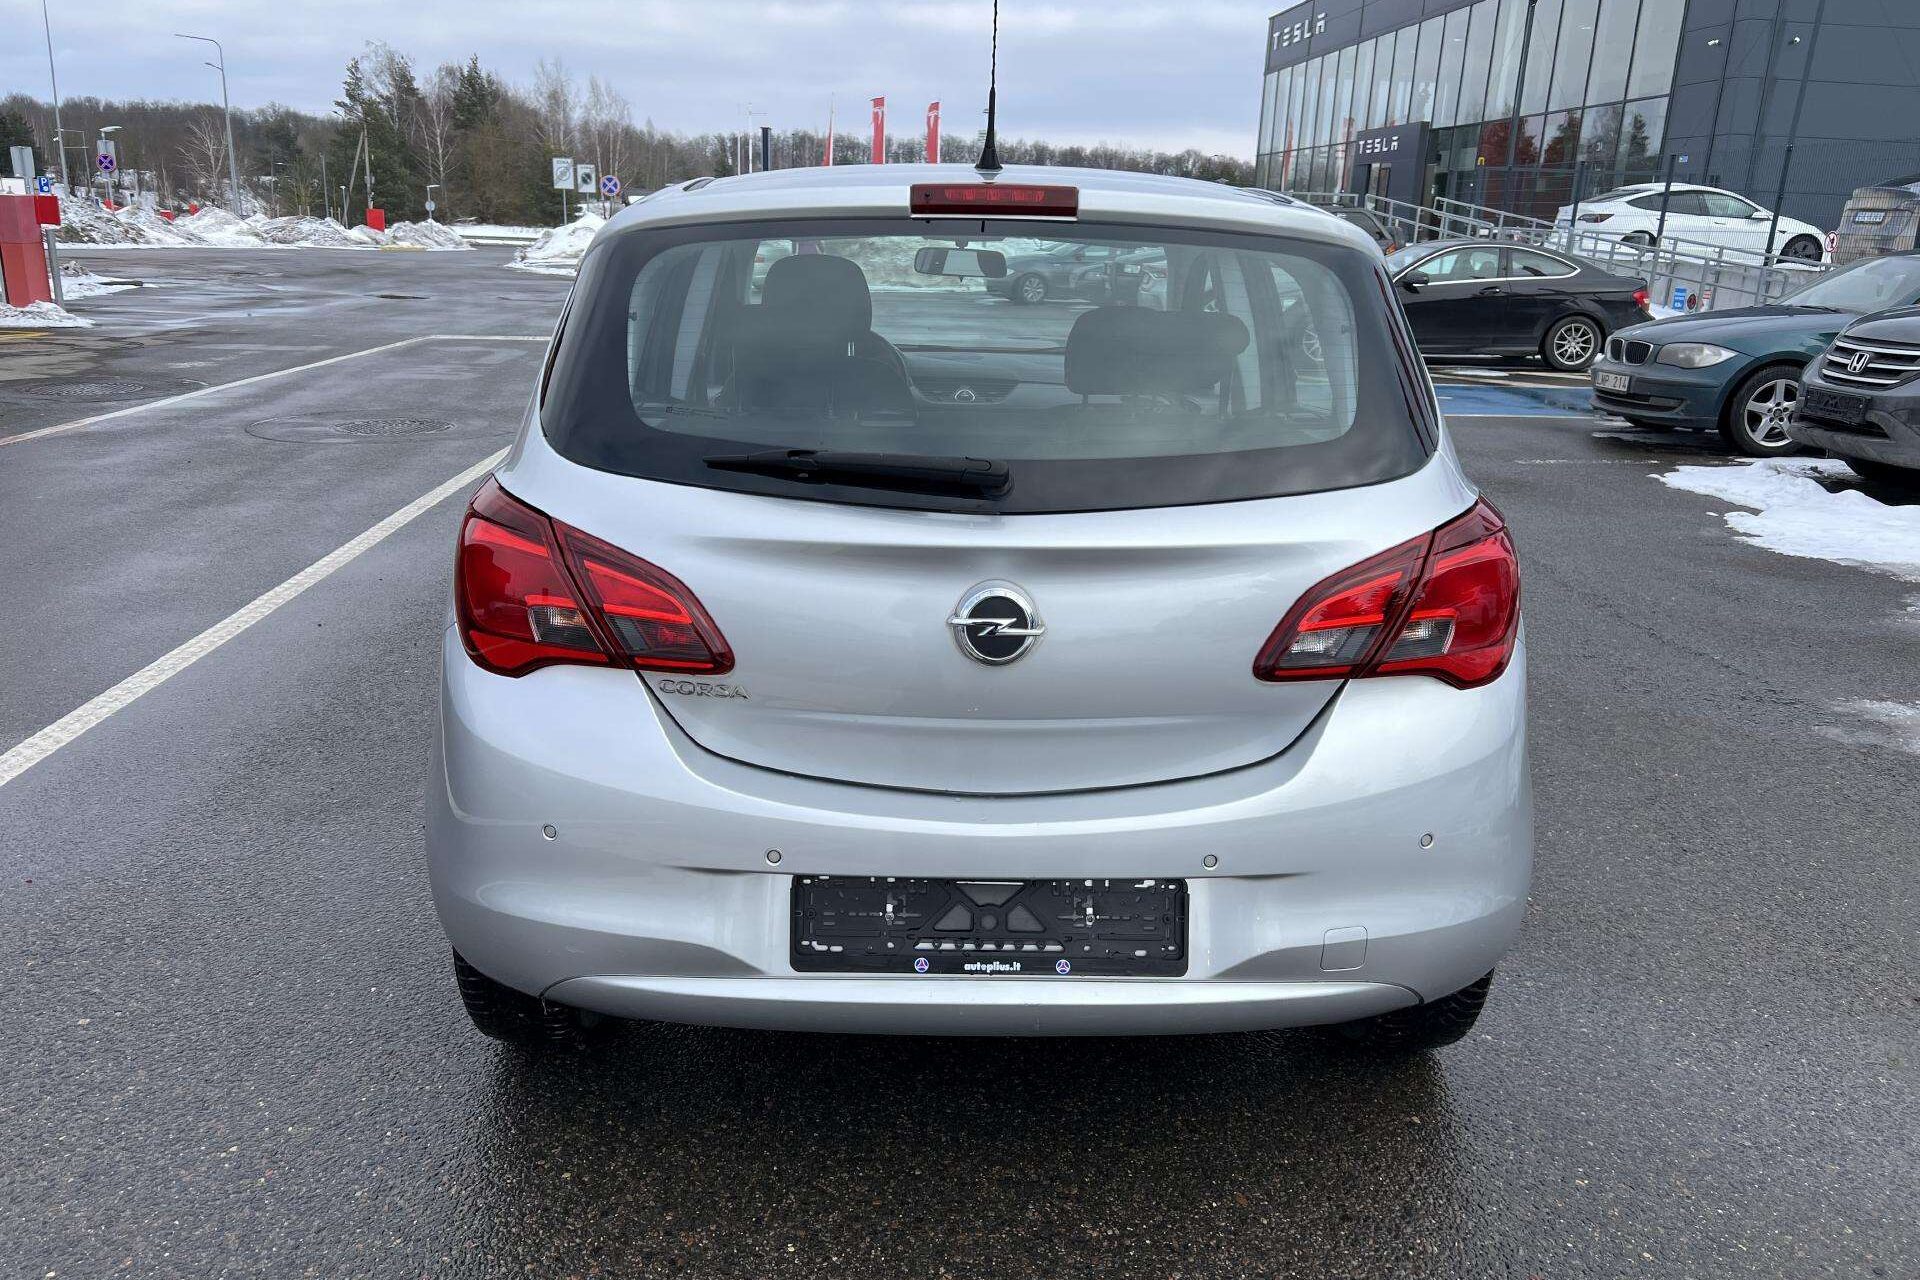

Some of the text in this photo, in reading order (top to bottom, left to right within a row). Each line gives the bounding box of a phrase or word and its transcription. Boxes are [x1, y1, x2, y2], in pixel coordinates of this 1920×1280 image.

[1273, 12, 1326, 50] TESLA
[1359, 136, 1399, 154] TESLA
[41, 177, 48, 186] P
[659, 679, 750, 700] CORSA
[964, 961, 1021, 973] autoplius.lt
